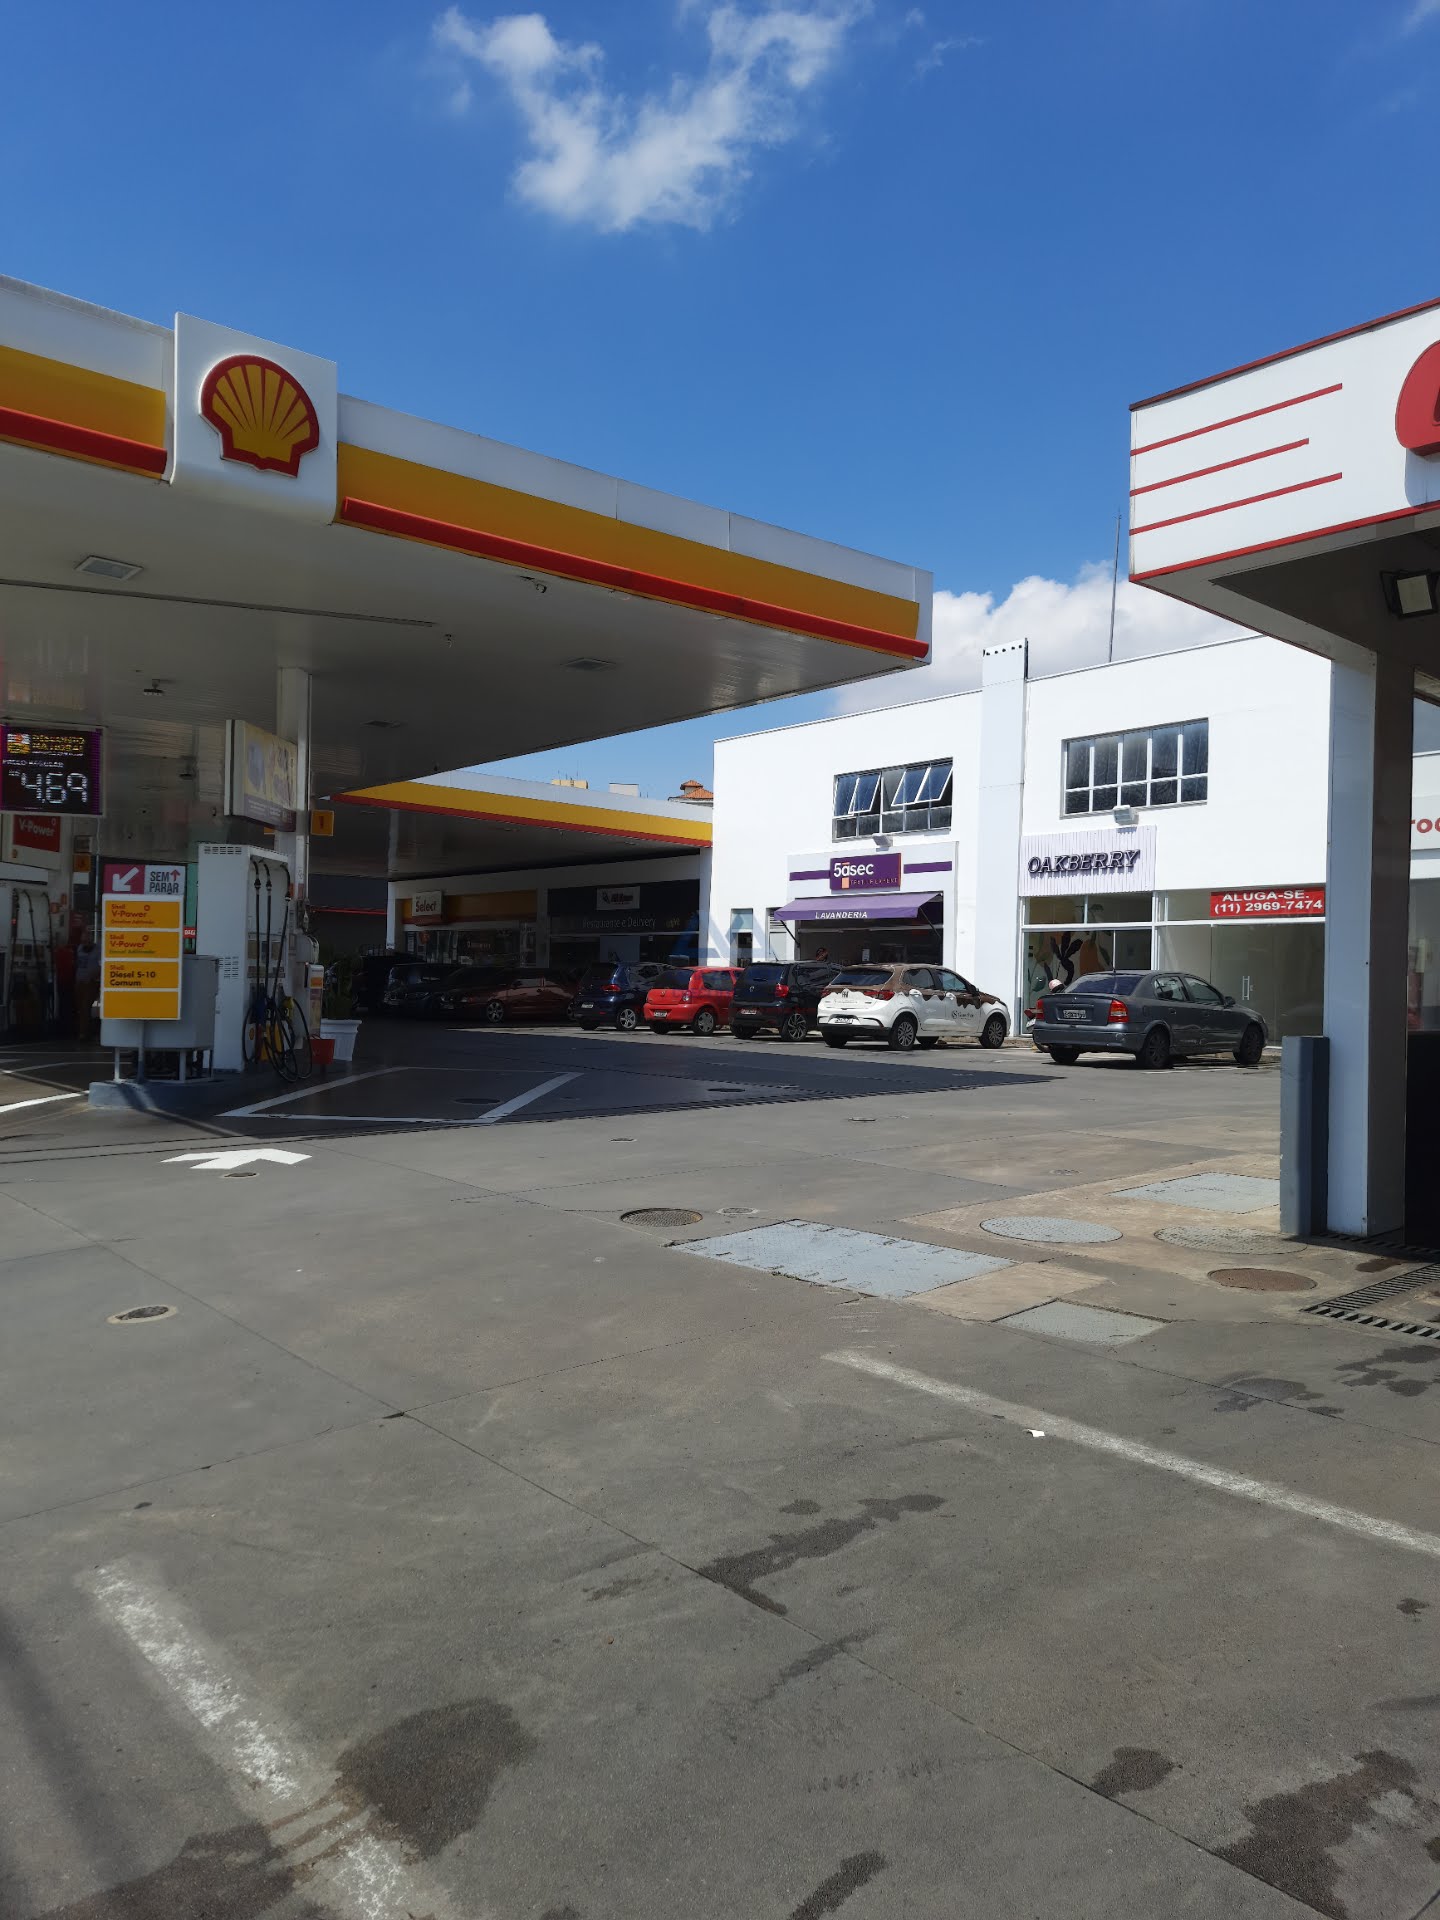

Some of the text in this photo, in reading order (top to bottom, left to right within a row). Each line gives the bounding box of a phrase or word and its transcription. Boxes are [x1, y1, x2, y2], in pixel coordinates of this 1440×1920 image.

[19, 818, 55, 837] V-Power
[1028, 849, 1141, 873] OAKBERRY
[150, 871, 170, 882] SEM
[149, 882, 179, 893] PARAR
[1222, 890, 1310, 902] ALUGA-SE.
[415, 899, 437, 913] Select
[1214, 900, 1323, 914] (11) 2969-7474
[111, 910, 147, 918] V-Power
[815, 911, 868, 920] LAVANDERIA
[627, 916, 656, 929] Delivery
[110, 940, 146, 948] V-Power
[110, 970, 156, 978] Diesel S-10
